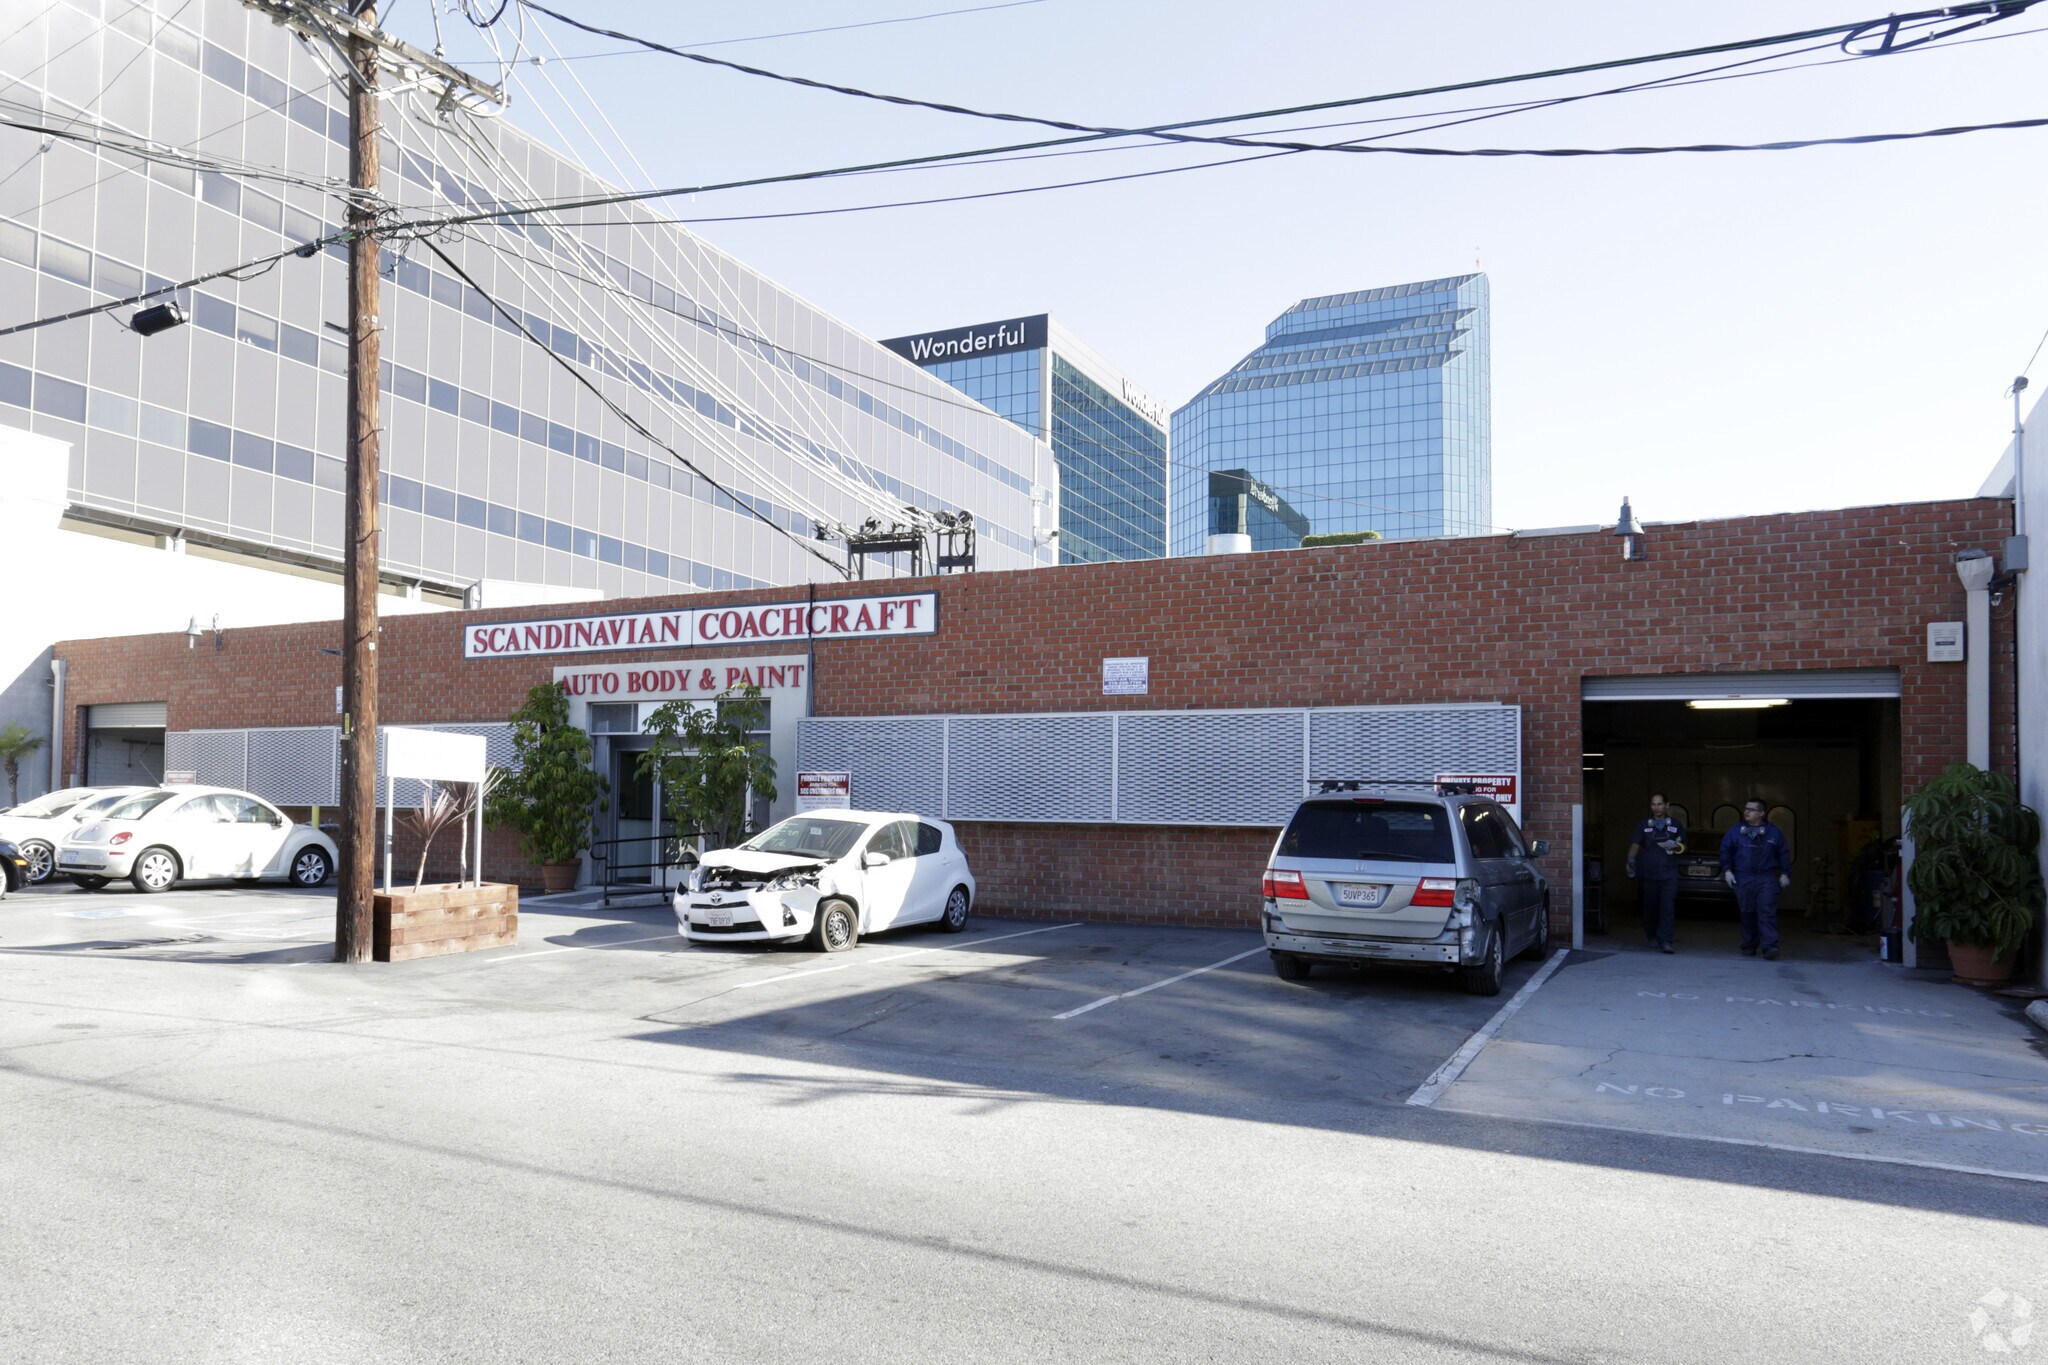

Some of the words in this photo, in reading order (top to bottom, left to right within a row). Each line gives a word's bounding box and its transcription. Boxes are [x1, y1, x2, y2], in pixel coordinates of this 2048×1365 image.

[909, 322, 1025, 360] Wonderful
[473, 615, 681, 654] SCANDINAVIAN
[698, 599, 922, 641] COACHCRAFT
[561, 672, 620, 697] AUTO
[627, 669, 692, 693] BODY
[698, 667, 717, 691] &
[725, 664, 805, 690] PAINT
[1472, 777, 1512, 786] PROPERTY
[1495, 793, 1512, 802] ONLY
[1343, 889, 1377, 902] 5UVP365
[1637, 991, 1700, 1000] NO
[1726, 997, 1955, 1018] PARKING
[1596, 1082, 1686, 1100] NO
[1721, 1093, 2048, 1137] PARKING
